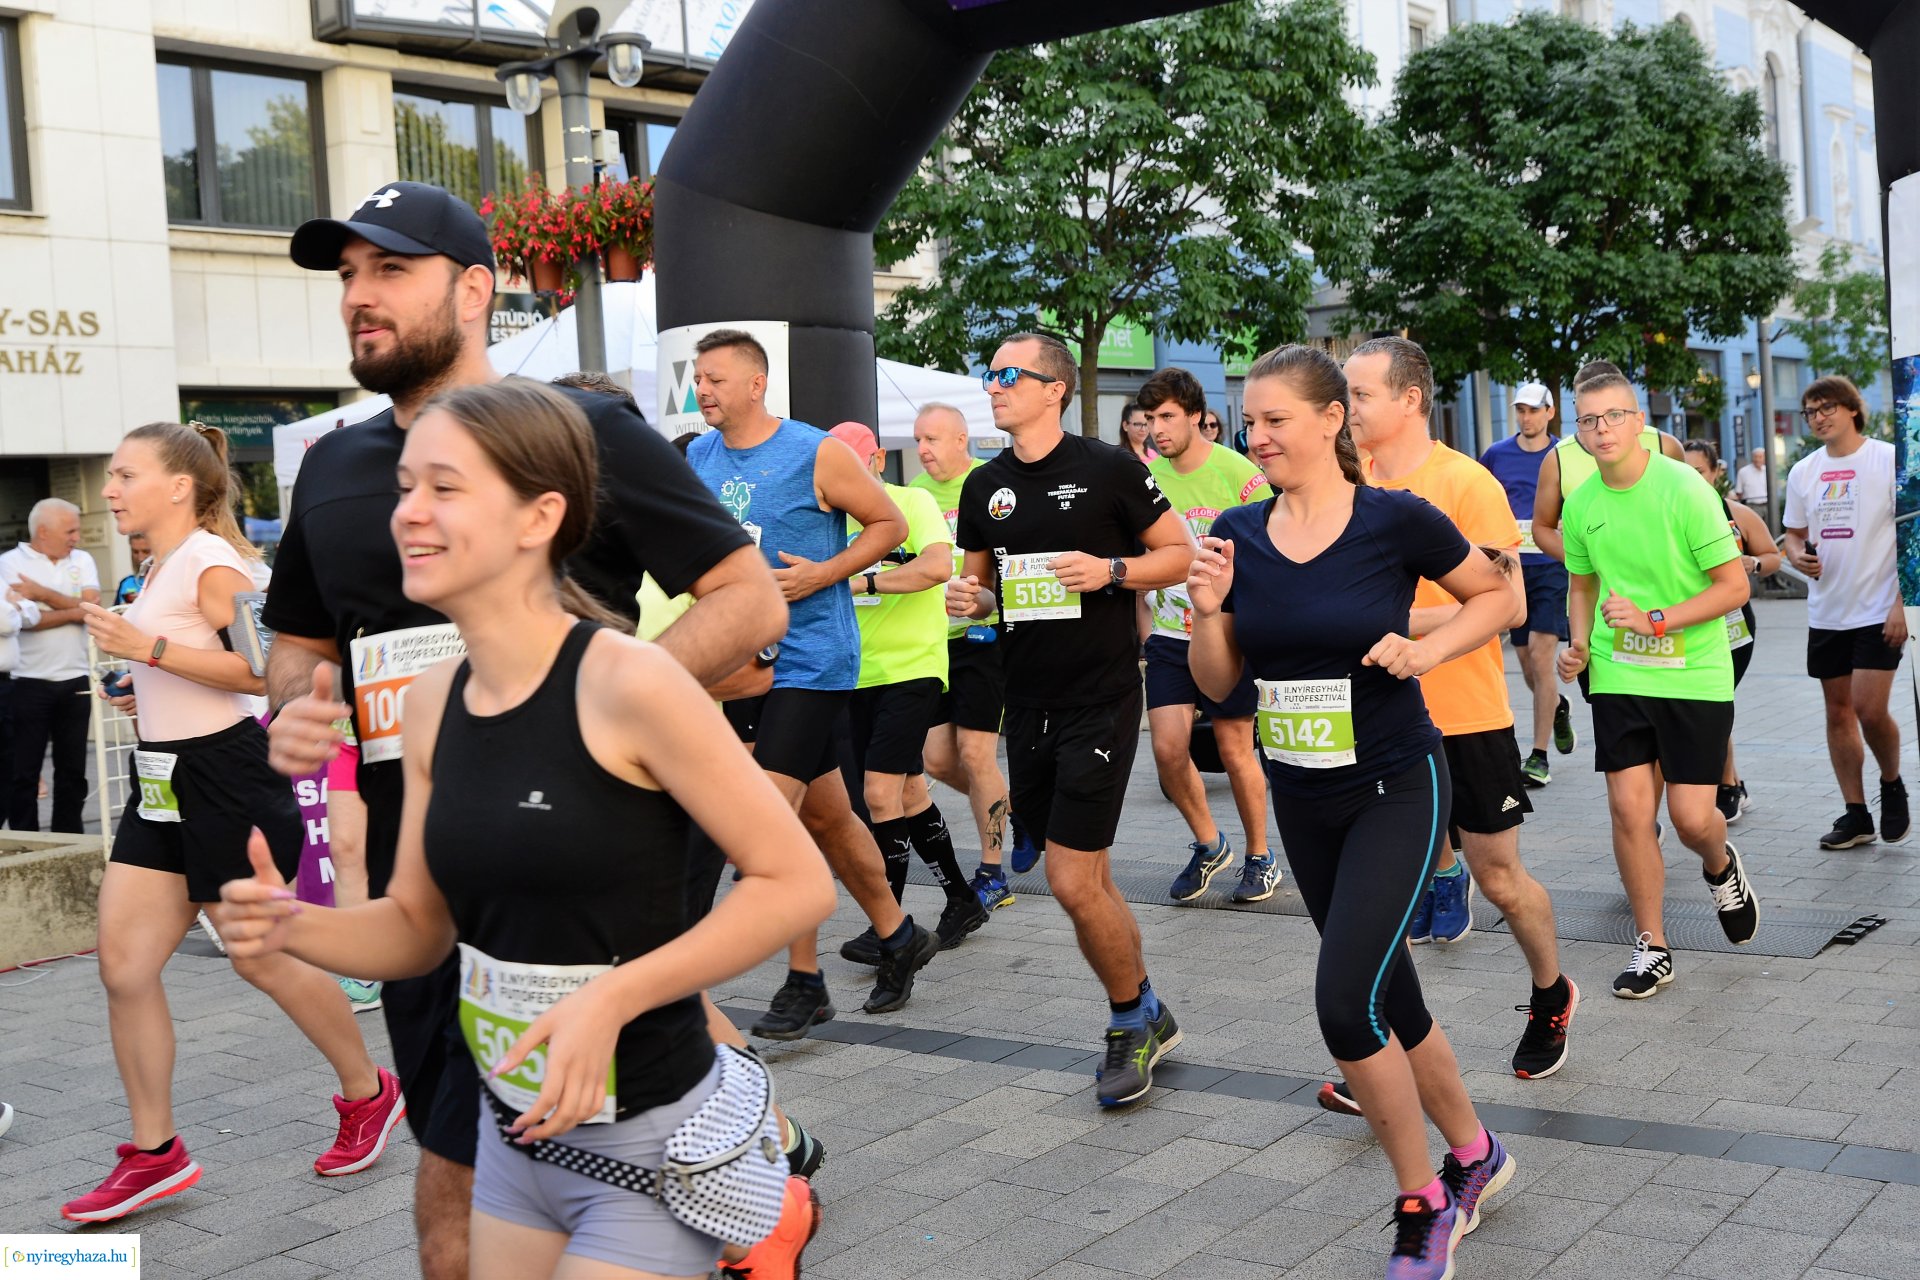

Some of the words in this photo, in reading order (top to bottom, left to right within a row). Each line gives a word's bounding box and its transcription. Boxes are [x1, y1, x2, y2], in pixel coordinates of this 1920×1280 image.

[491, 308, 545, 327] STÚDIÓ
[1015, 580, 1067, 606] 5139
[1622, 631, 1675, 655] 5098
[1268, 717, 1336, 748] 5142
[1501, 800, 1520, 813] adidas
